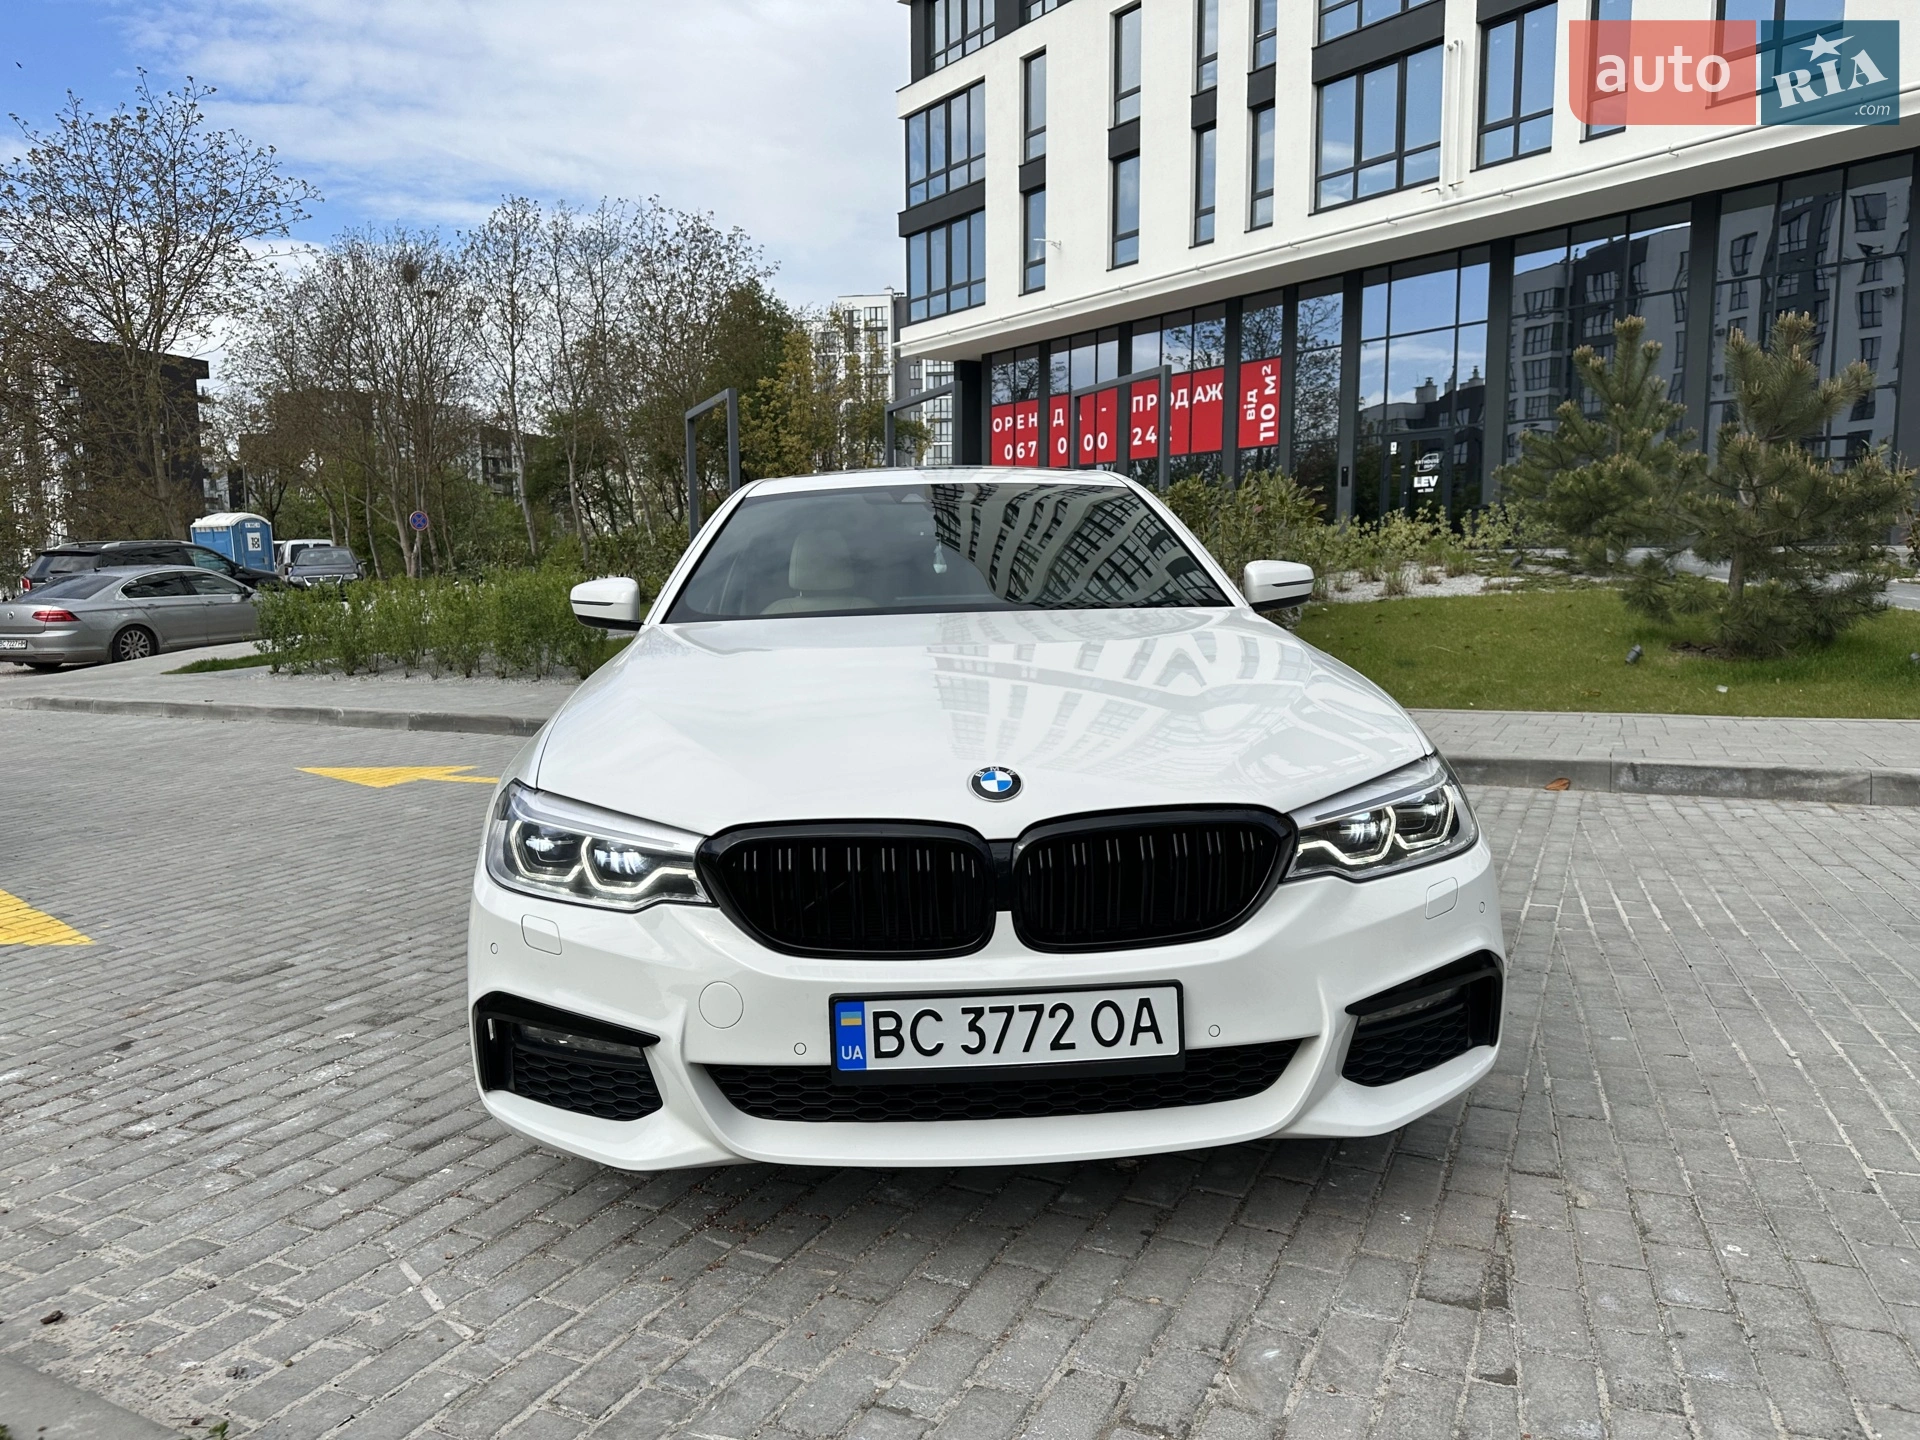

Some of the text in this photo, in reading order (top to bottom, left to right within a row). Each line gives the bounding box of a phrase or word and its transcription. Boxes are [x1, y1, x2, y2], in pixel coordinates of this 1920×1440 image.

[992, 408, 1082, 433] ОРЕНД
[1004, 440, 1037, 460] 067
[1413, 475, 1439, 488] LEV
[974, 765, 1016, 778] BMW
[872, 997, 1164, 1059] BC 3772 OA
[841, 1045, 863, 1060] UA
